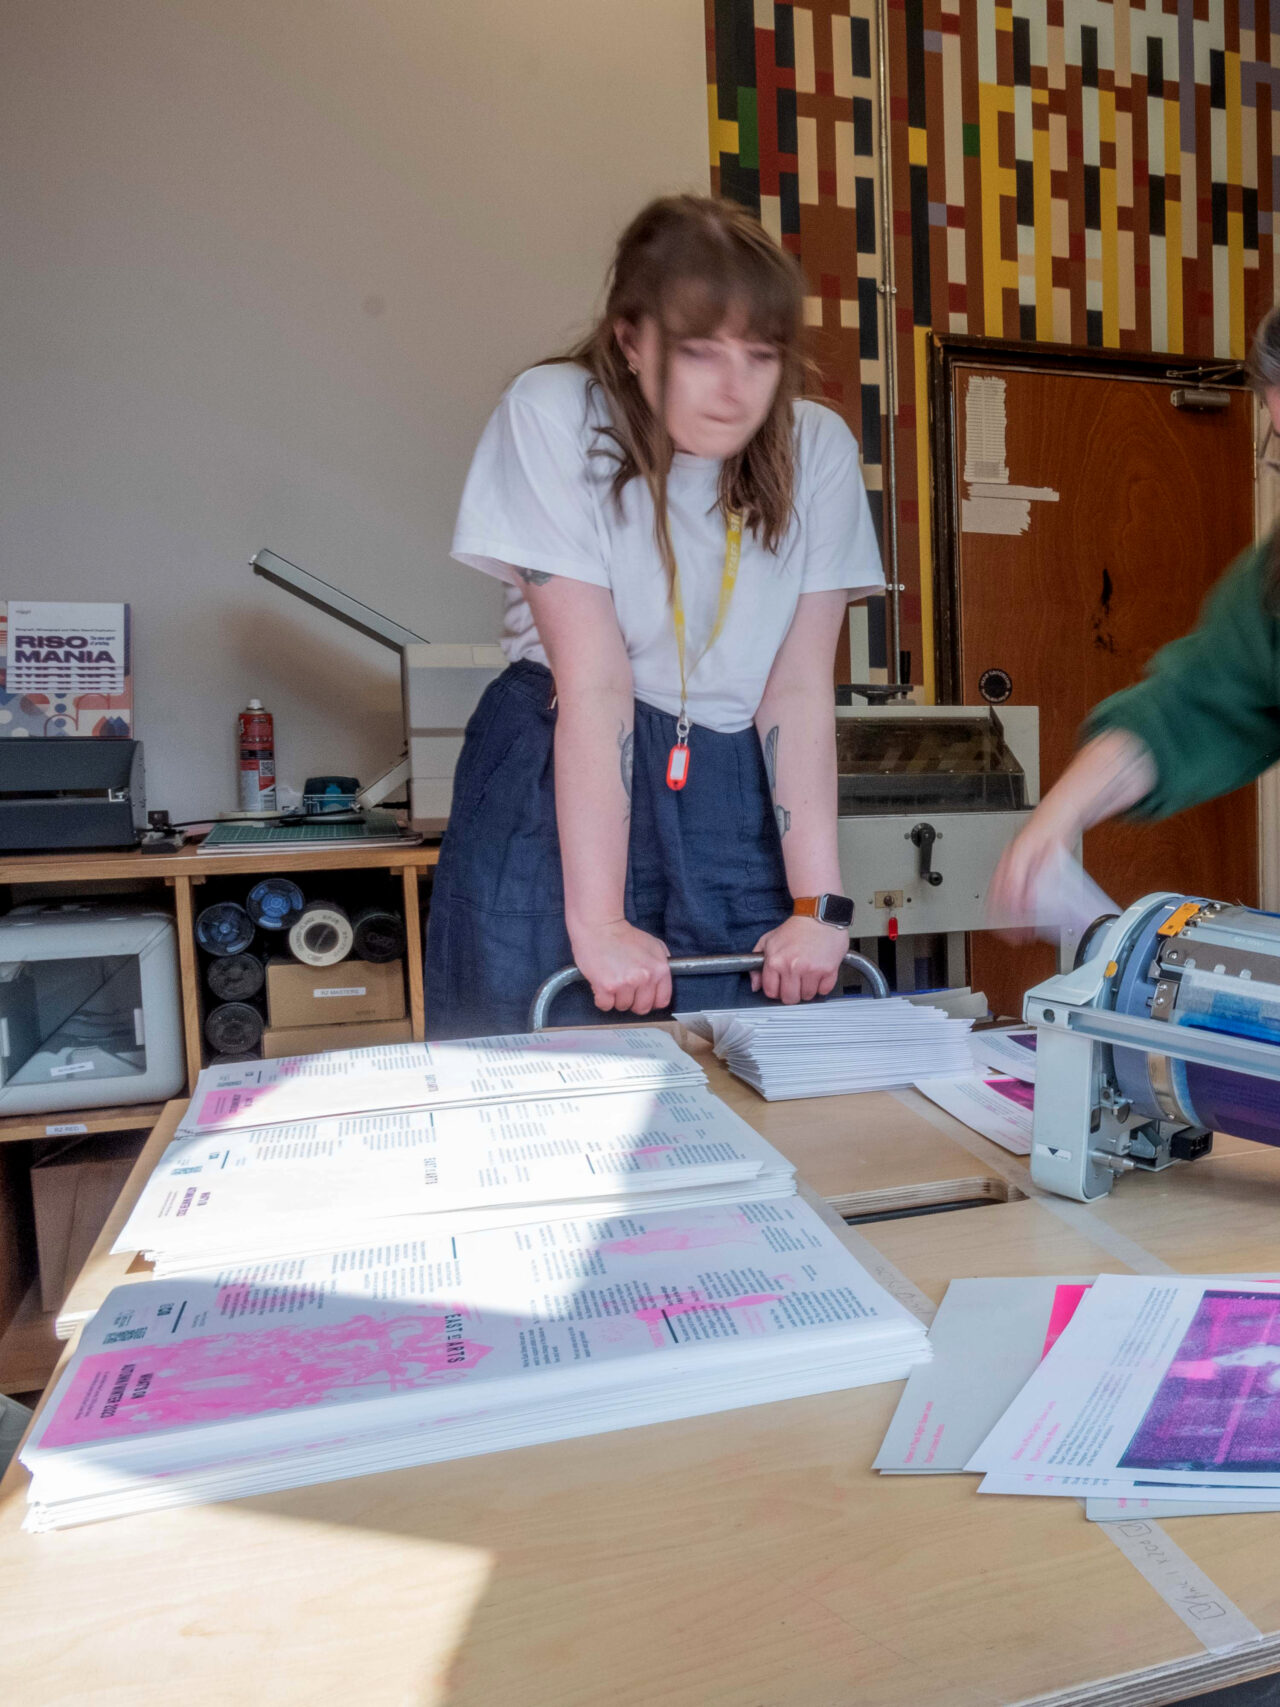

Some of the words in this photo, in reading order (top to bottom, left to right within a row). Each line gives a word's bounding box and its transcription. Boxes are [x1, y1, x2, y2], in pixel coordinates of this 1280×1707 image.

[15, 635, 88, 649] RISO
[15, 650, 117, 664] MANIA
[445, 1313, 463, 1333] EAST
[446, 1341, 465, 1363] ARTS
